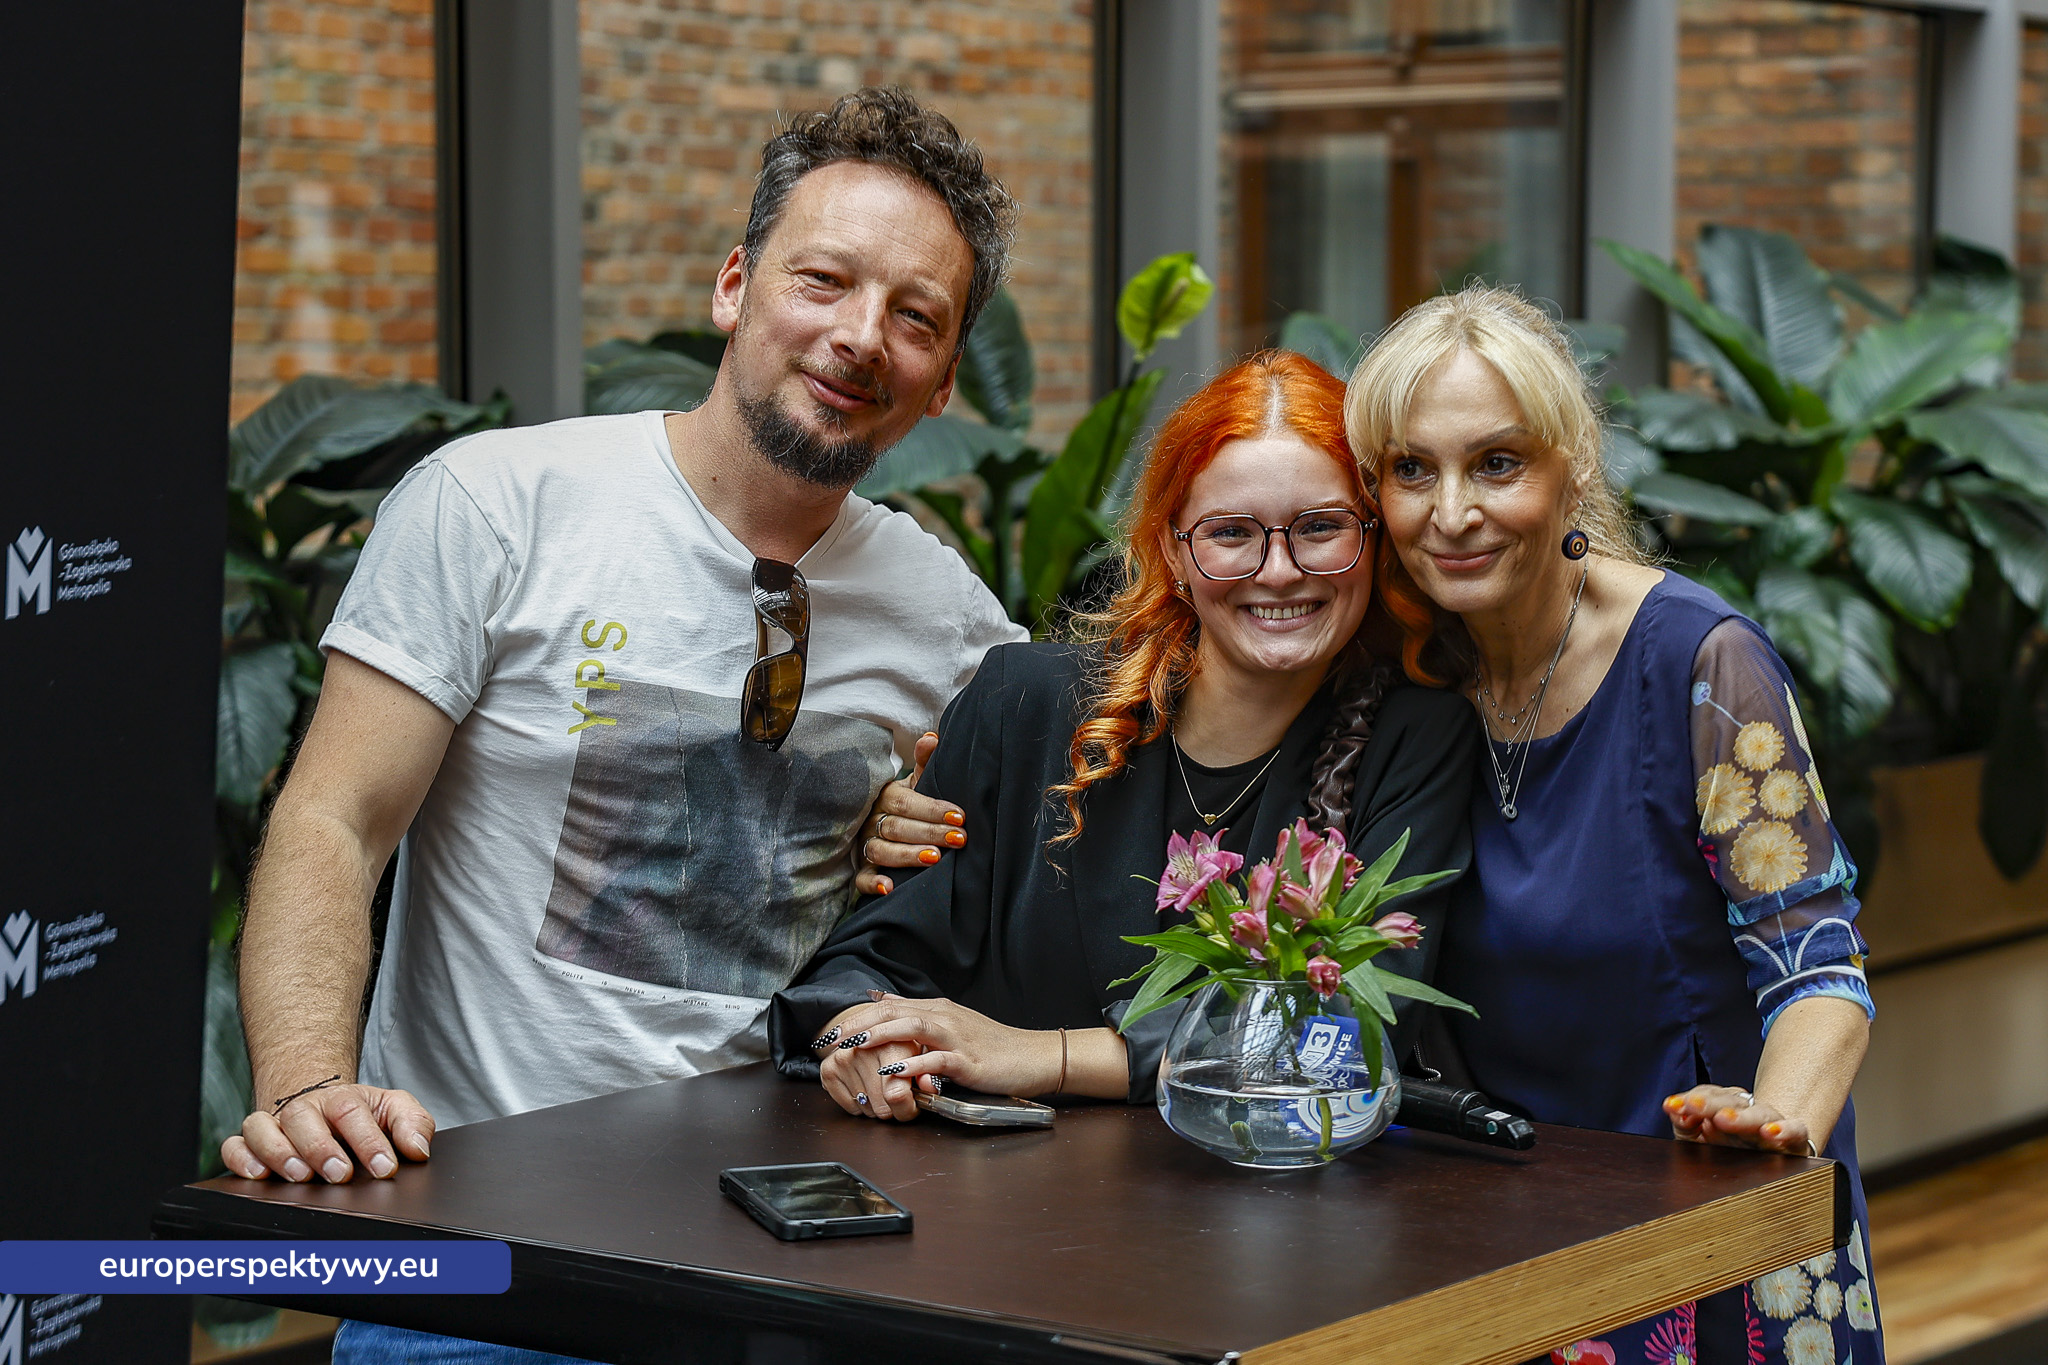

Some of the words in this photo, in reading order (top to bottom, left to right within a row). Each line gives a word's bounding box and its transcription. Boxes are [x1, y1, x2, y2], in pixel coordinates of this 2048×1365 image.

[567, 619, 628, 735] YPS
[561, 970, 584, 980] POLITE
[624, 986, 646, 995] NEVER
[683, 998, 710, 1007] MISTAKE.
